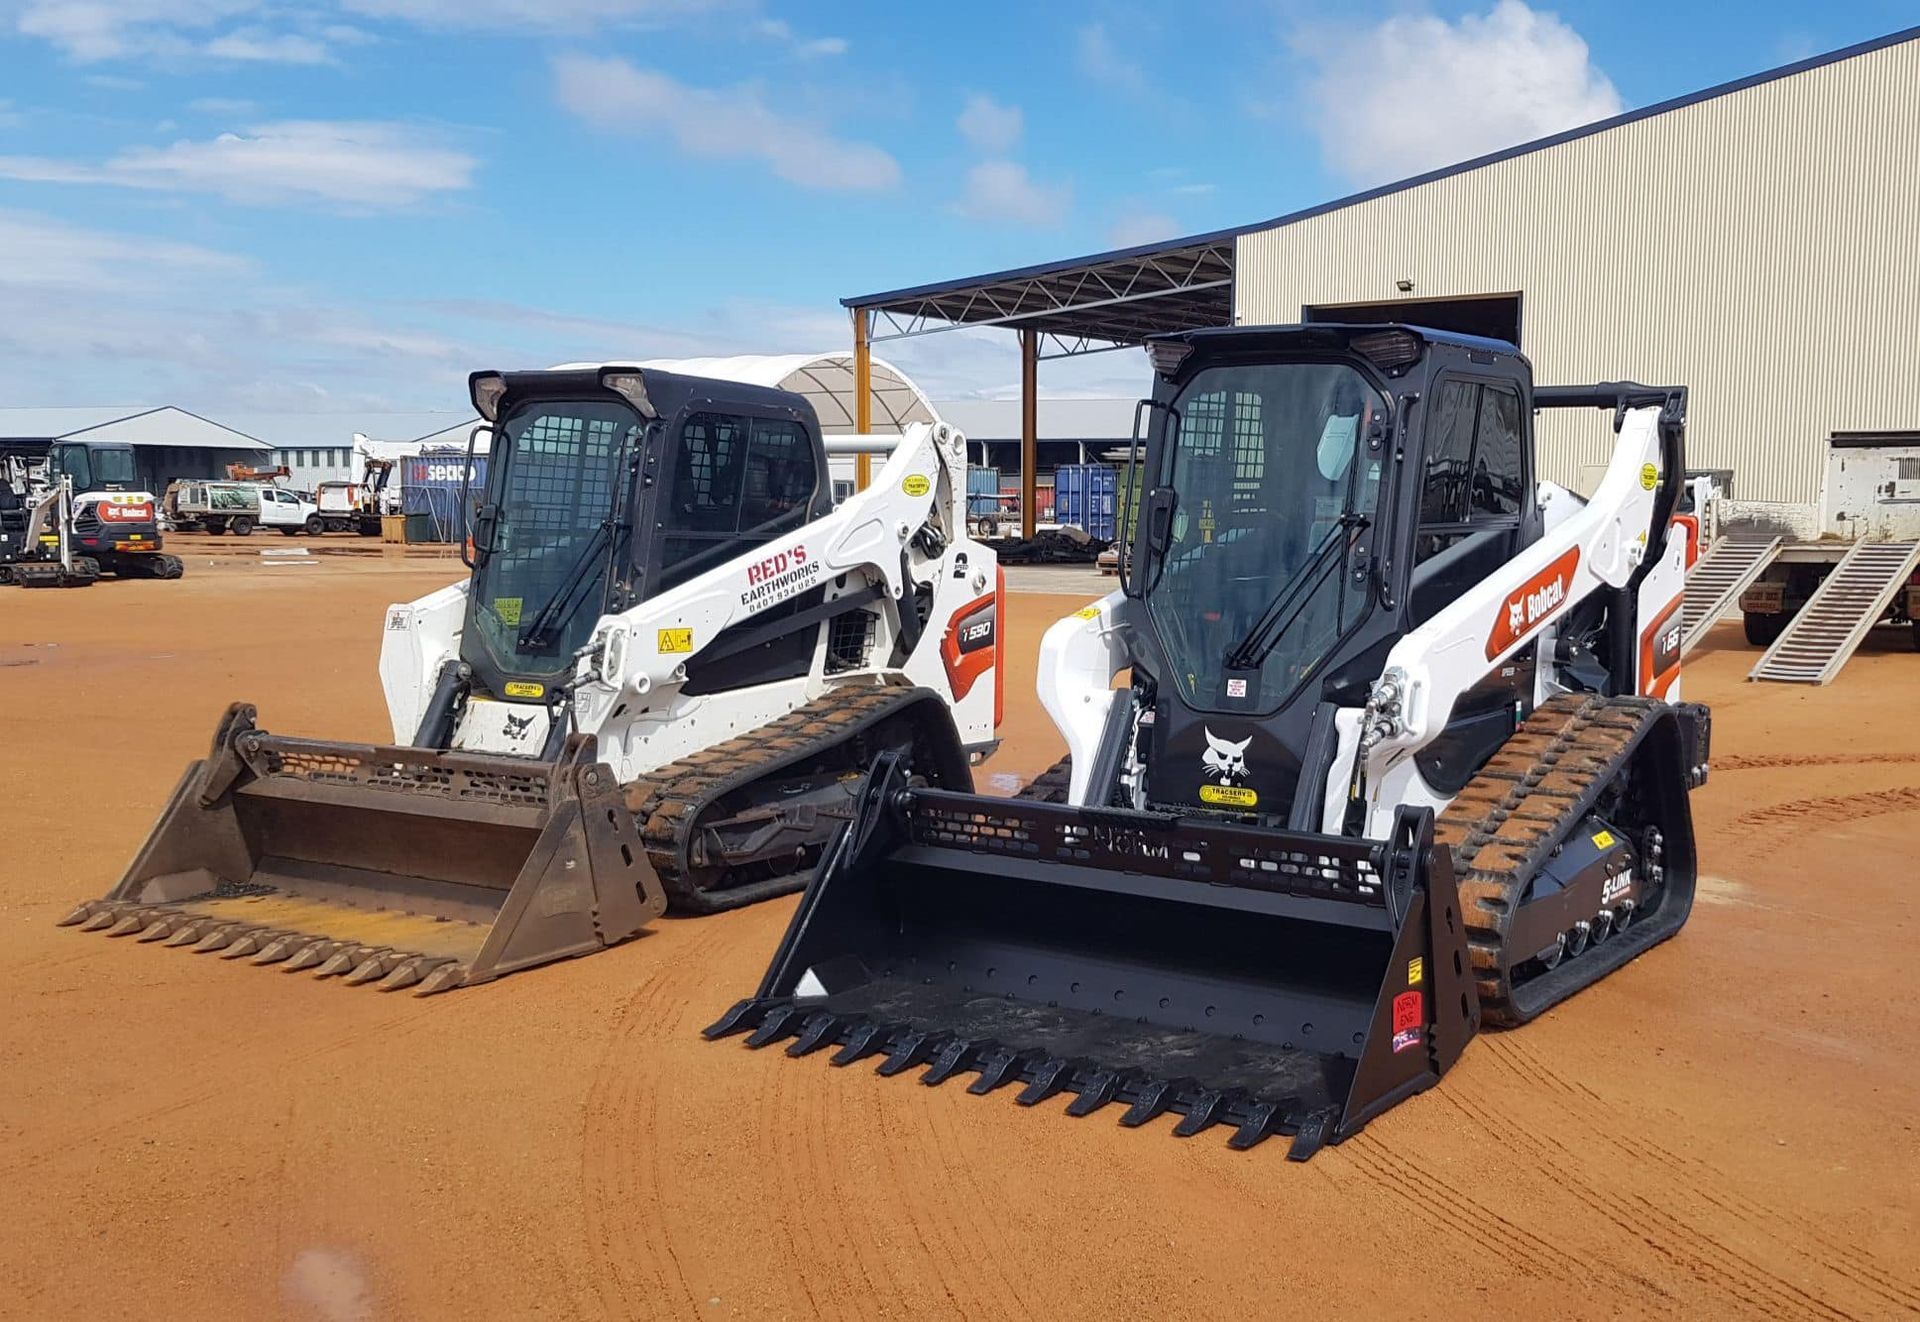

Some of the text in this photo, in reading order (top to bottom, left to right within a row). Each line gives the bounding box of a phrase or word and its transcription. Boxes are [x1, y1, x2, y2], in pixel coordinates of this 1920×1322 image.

[740, 560, 820, 606] EARTHWORKS
[747, 544, 807, 587] RED'S
[953, 552, 968, 579] 2
[1527, 573, 1563, 624] Bobcat
